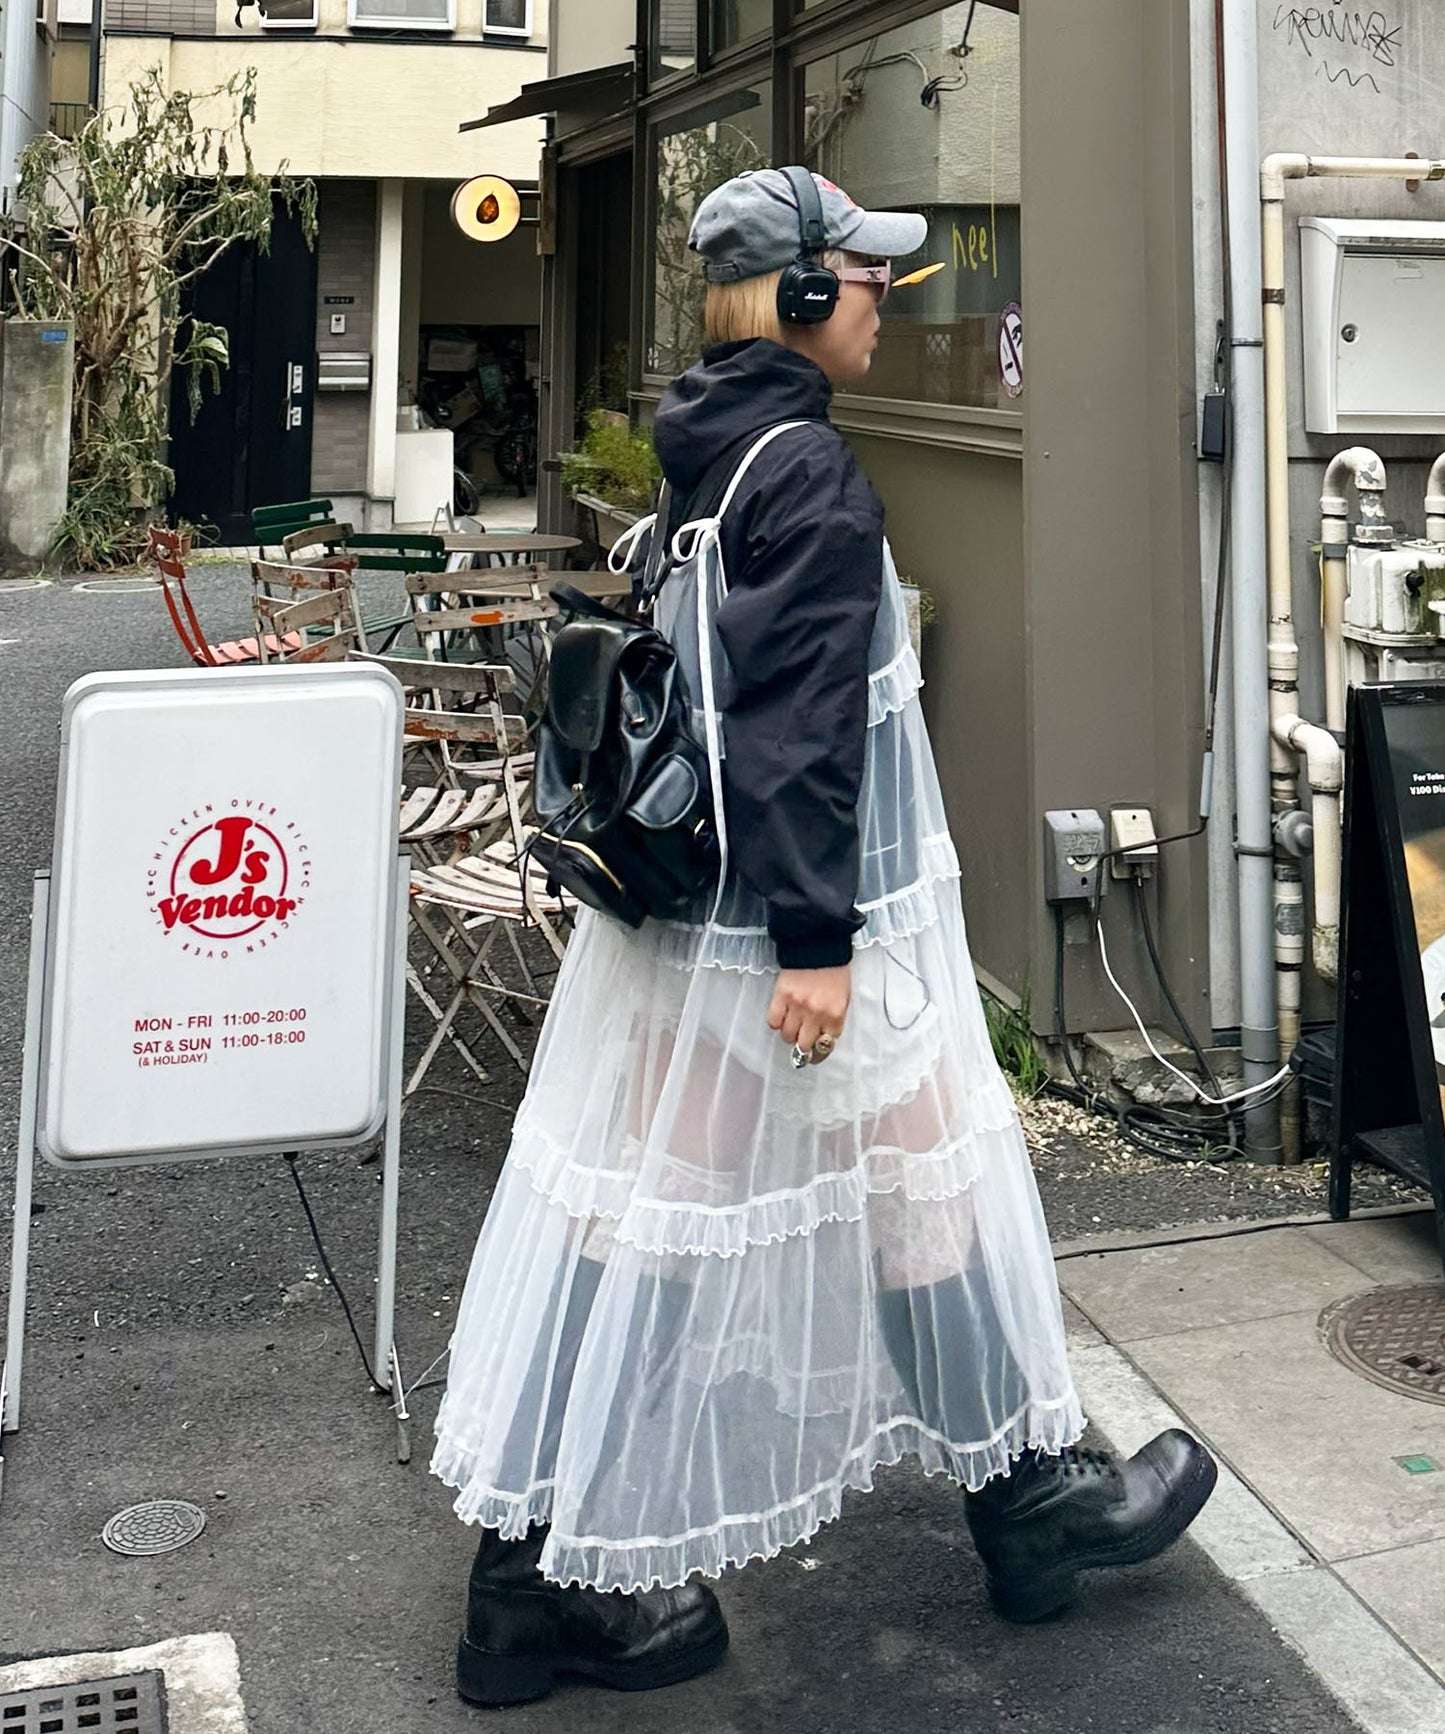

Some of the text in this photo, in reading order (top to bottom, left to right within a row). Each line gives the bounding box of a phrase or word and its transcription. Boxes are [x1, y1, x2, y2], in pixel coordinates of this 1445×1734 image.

[147, 799, 311, 877] CHICKEN OVER RICE
[189, 816, 270, 885] J's
[157, 886, 297, 929] Vendor
[182, 942, 229, 959] OVER
[134, 1018, 173, 1033] MON
[187, 1015, 213, 1029] FRI
[222, 1008, 307, 1027] 11:00-20:00
[132, 1030, 306, 1055] SAT & SUN 11:00-18:00
[153, 1052, 208, 1066] HOLIDAY)
